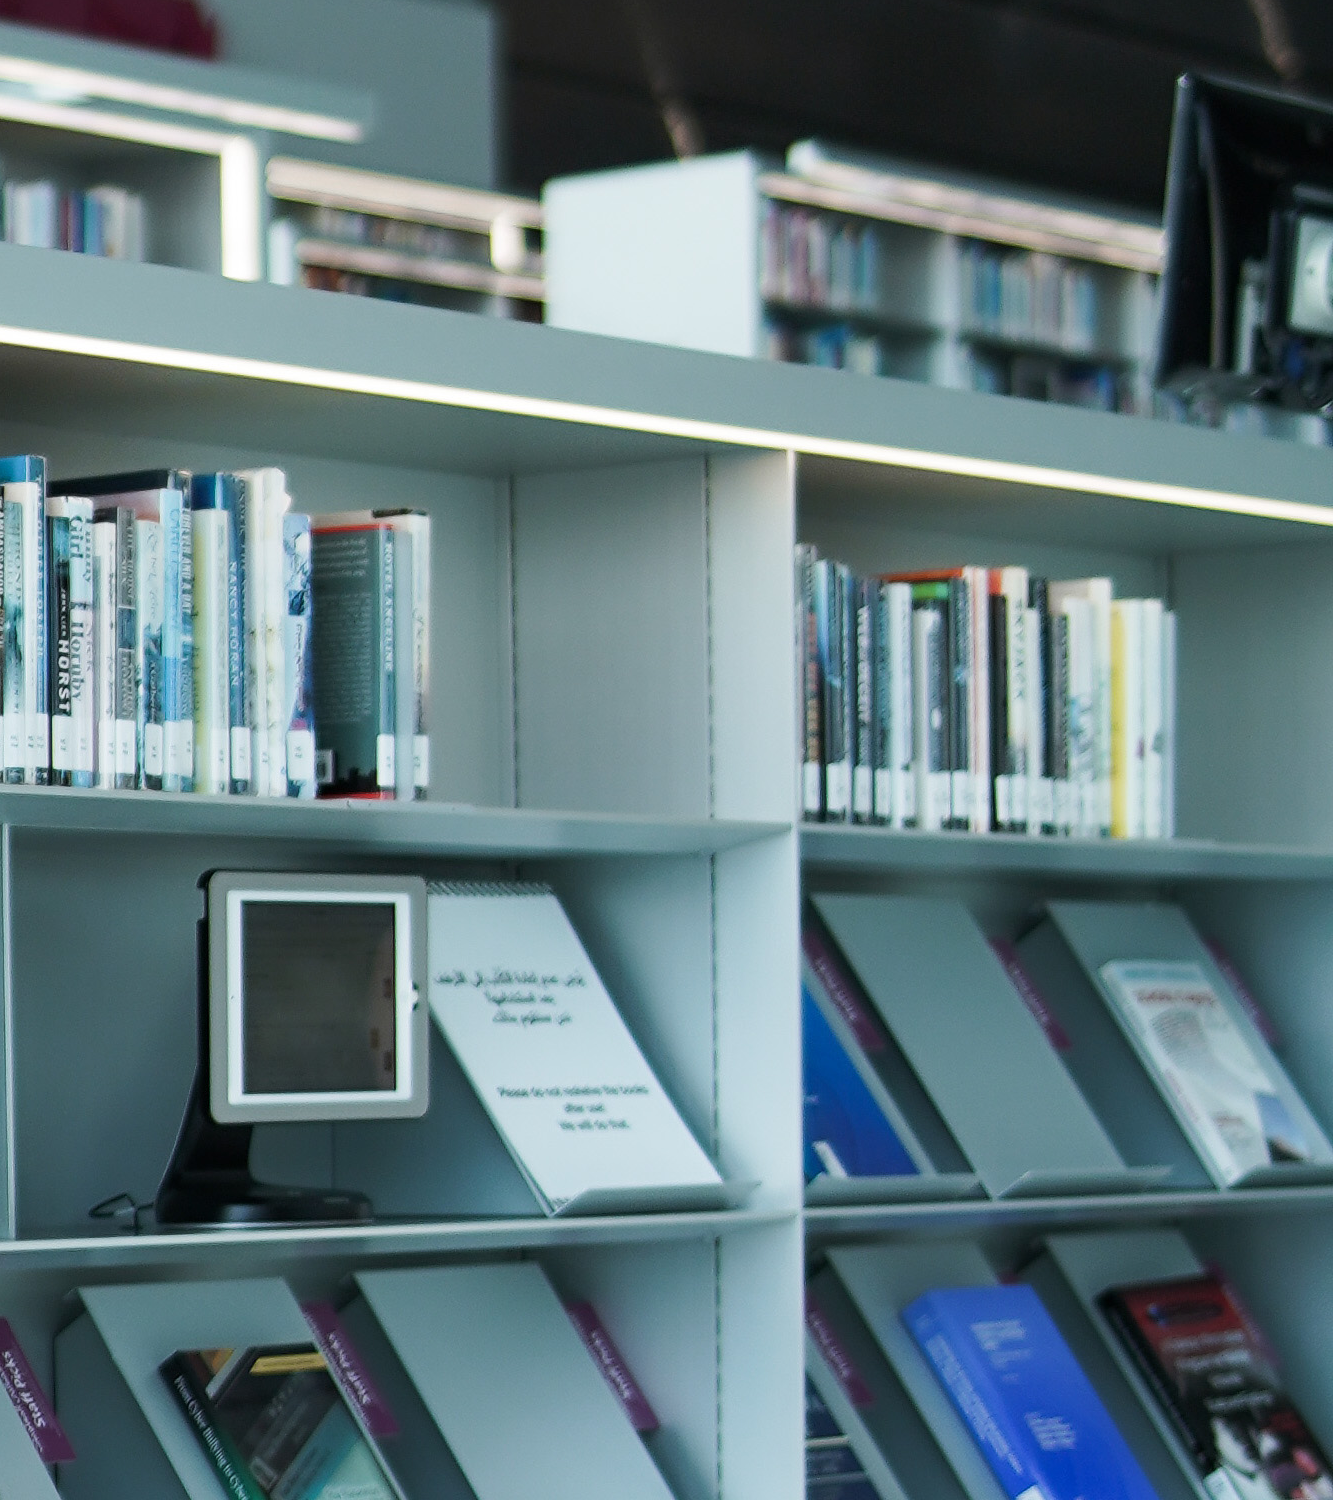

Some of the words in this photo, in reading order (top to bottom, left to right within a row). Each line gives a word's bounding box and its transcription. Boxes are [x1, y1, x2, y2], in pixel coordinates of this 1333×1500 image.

[229, 561, 238, 621] NANCY
[59, 639, 70, 711] HORST
[230, 627, 239, 685] HORAN
[2, 1351, 30, 1389] Picks
[19, 1391, 46, 1429] Staff
